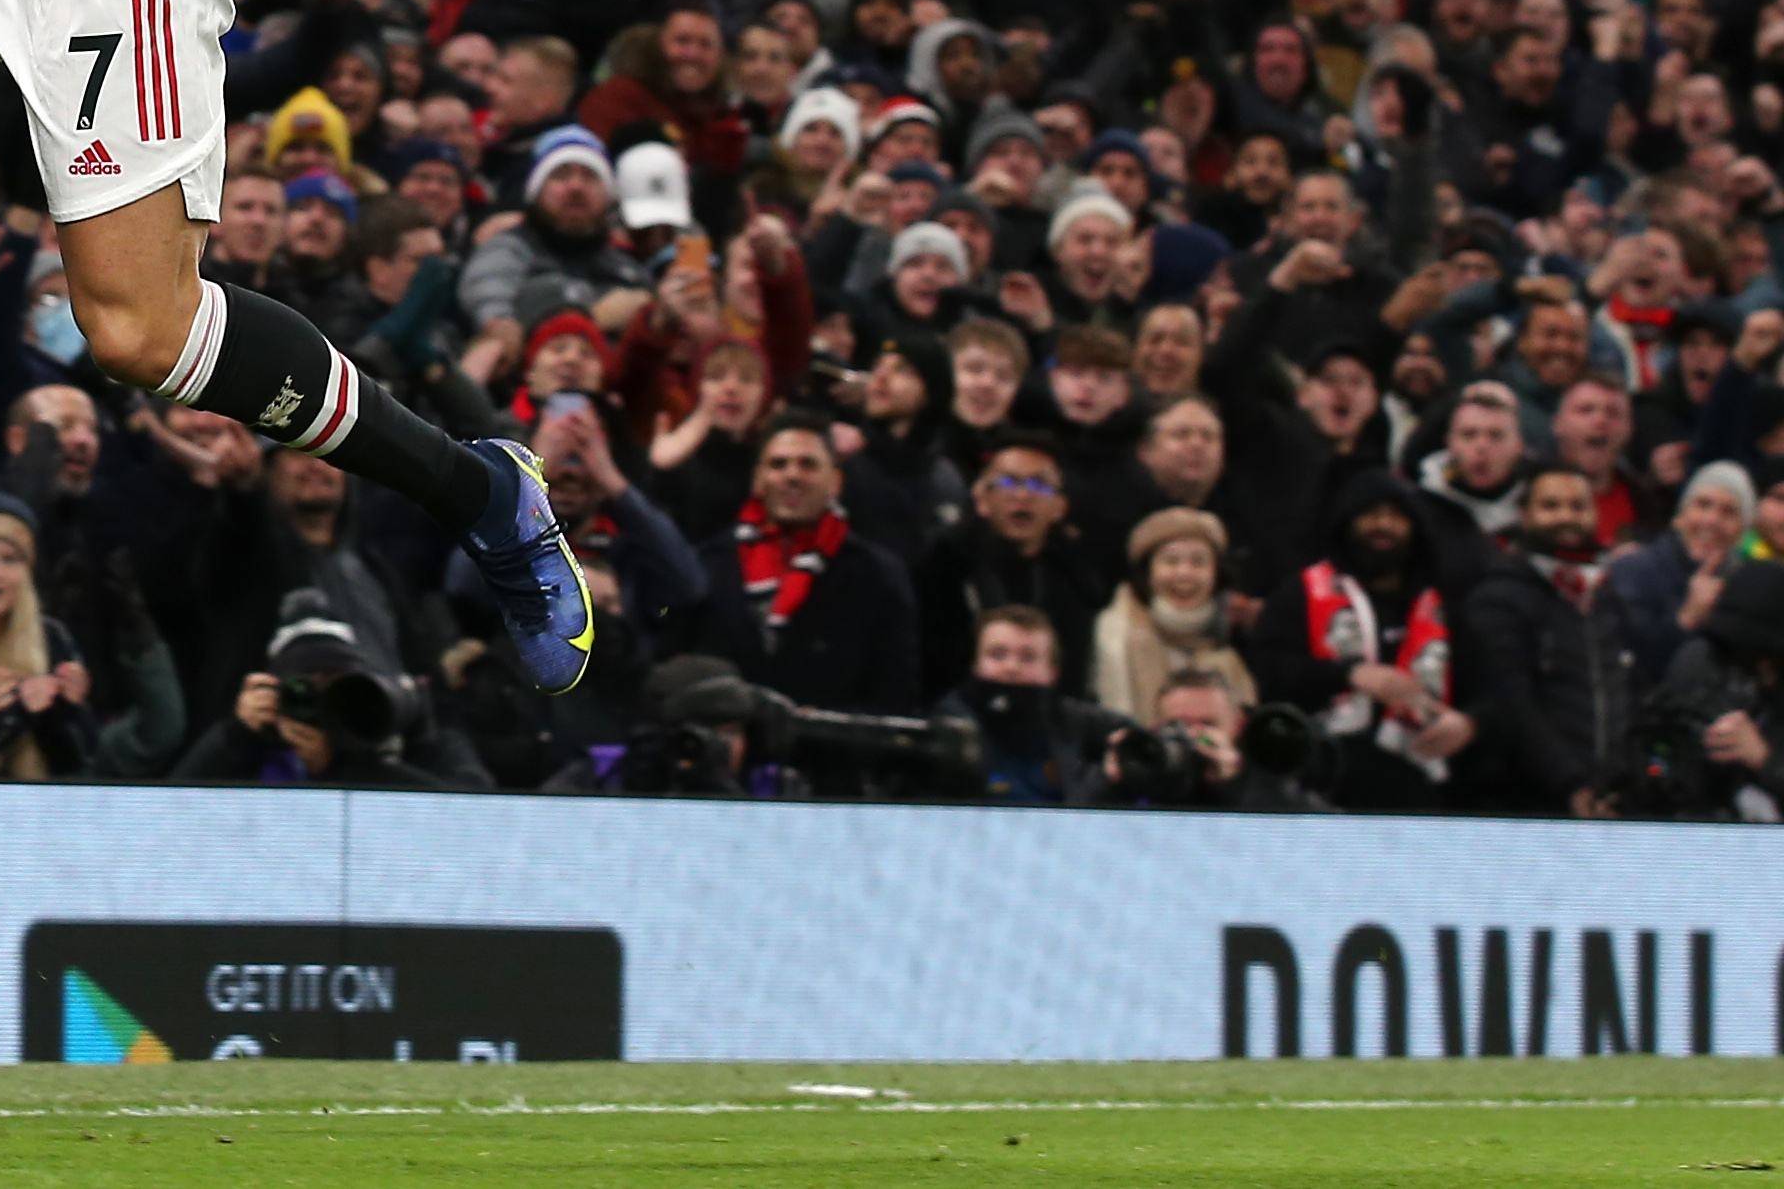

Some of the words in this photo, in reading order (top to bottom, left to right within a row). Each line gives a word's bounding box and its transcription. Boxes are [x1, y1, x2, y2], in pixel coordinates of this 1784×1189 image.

[68, 33, 123, 131] 7
[68, 162, 122, 176] adidas
[206, 963, 286, 1013] GET
[291, 963, 326, 1013] IT
[332, 964, 395, 1013] ON
